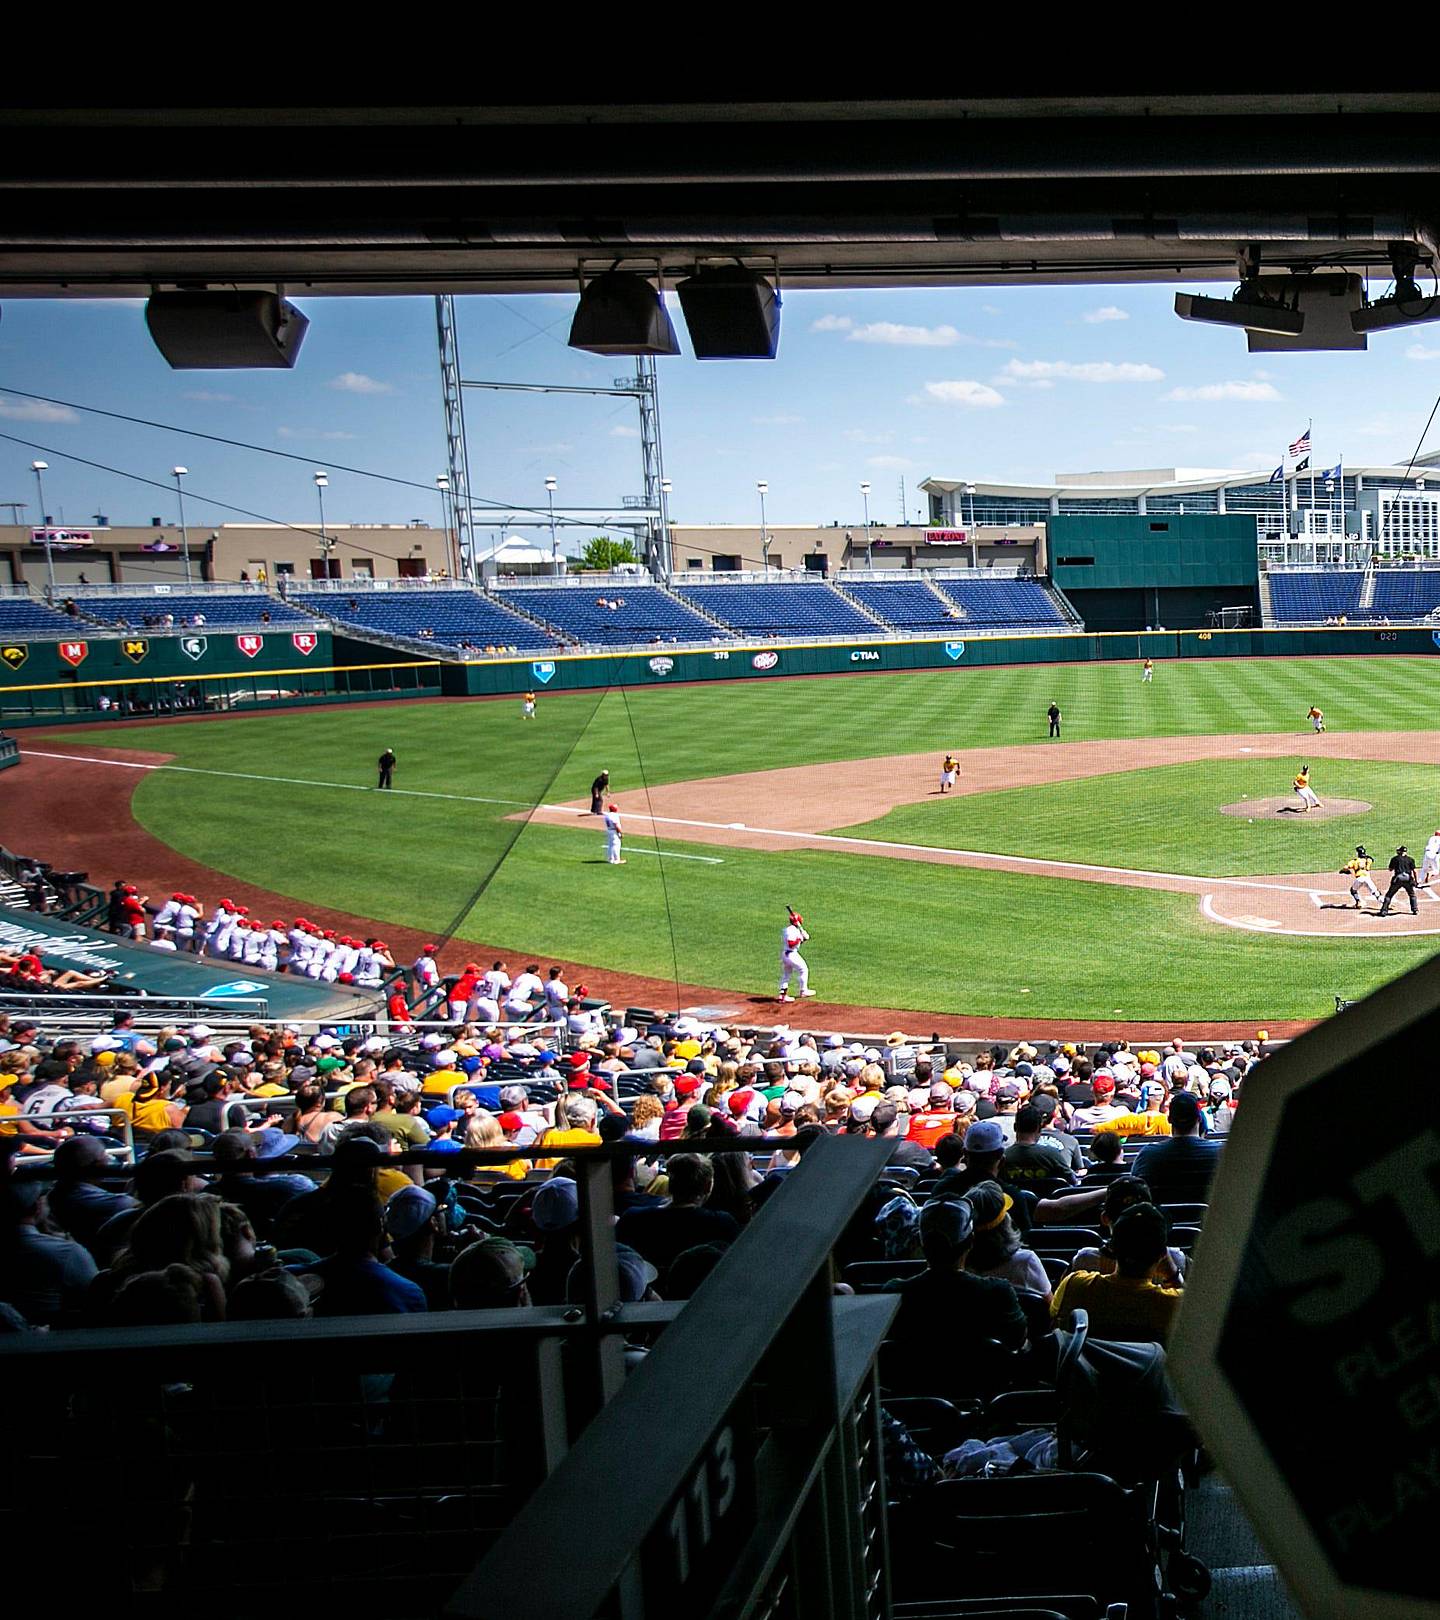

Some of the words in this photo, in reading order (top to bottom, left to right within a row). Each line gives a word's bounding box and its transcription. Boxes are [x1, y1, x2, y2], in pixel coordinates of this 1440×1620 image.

[244, 637, 258, 649] N
[300, 636, 312, 647] R
[67, 644, 81, 657] M
[127, 642, 144, 654] M
[714, 651, 729, 660] 375
[860, 651, 880, 660] TIAA
[671, 1426, 736, 1584] 113
